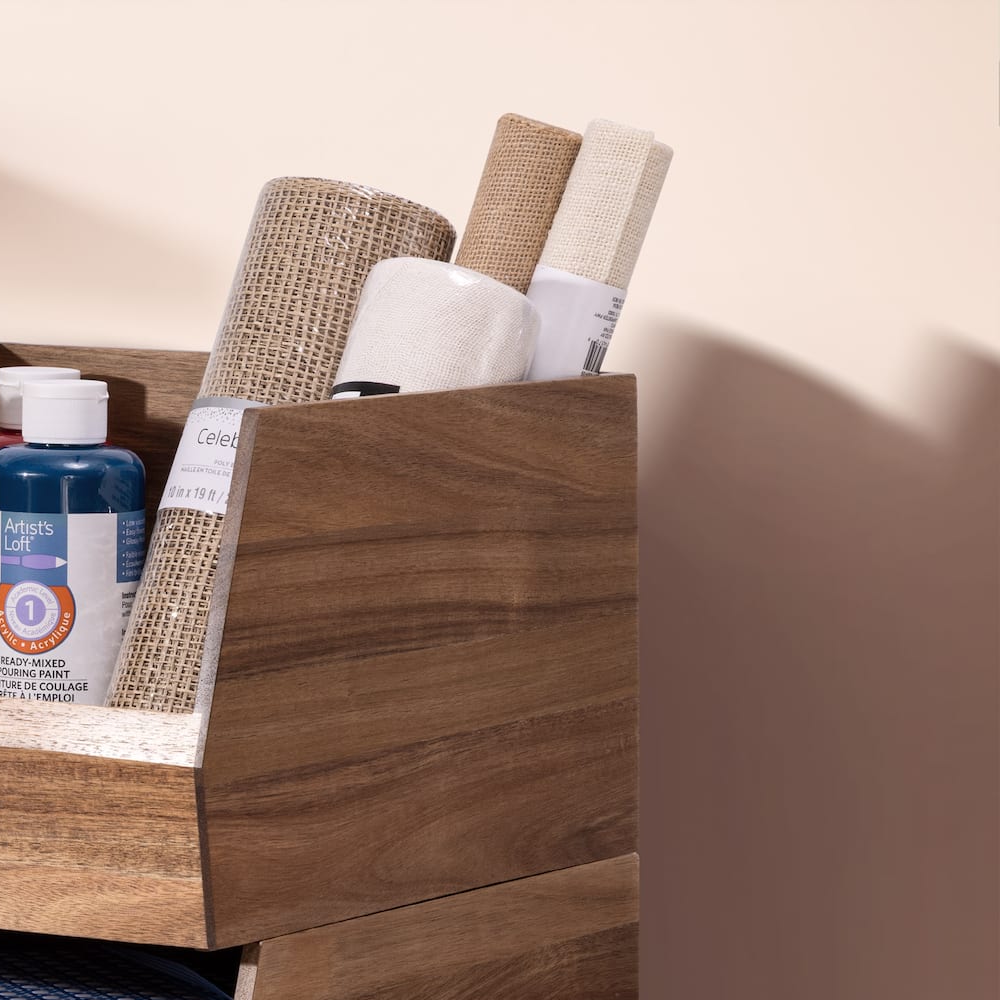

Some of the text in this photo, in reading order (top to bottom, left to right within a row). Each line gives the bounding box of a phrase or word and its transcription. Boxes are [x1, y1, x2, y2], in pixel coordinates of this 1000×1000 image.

[197, 428, 240, 448] Celeb
[194, 487, 206, 499] 19
[208, 489, 216, 501] ft
[4, 517, 54, 536] Artist's
[24, 600, 34, 620] 1
[30, 611, 71, 651] Acrylique
[0, 656, 66, 668] READY-MIXED
[39, 670, 71, 679] PAINT
[24, 681, 37, 691] DE
[39, 682, 89, 692] COULAGE
